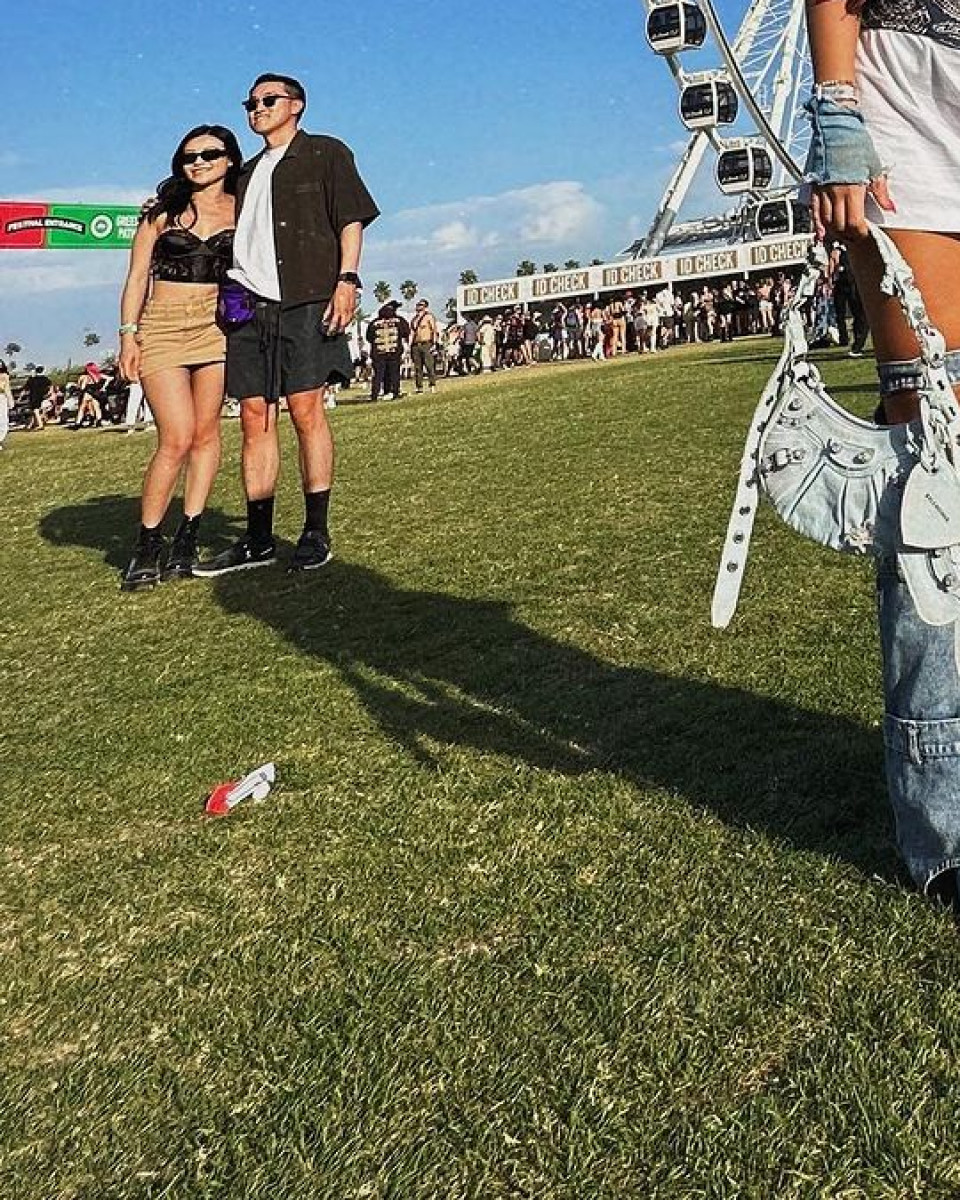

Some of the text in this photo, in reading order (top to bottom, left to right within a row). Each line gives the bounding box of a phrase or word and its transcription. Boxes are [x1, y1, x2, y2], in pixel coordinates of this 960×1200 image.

[8, 219, 83, 232] FESTIVAL ENTRANCE
[116, 215, 138, 226] GREE
[754, 239, 809, 264] ID CHECK
[606, 263, 656, 286] ID CHECK
[680, 252, 734, 275] ID CHECK
[467, 283, 515, 305] ID CHECK
[536, 272, 587, 296] ID CHECK
